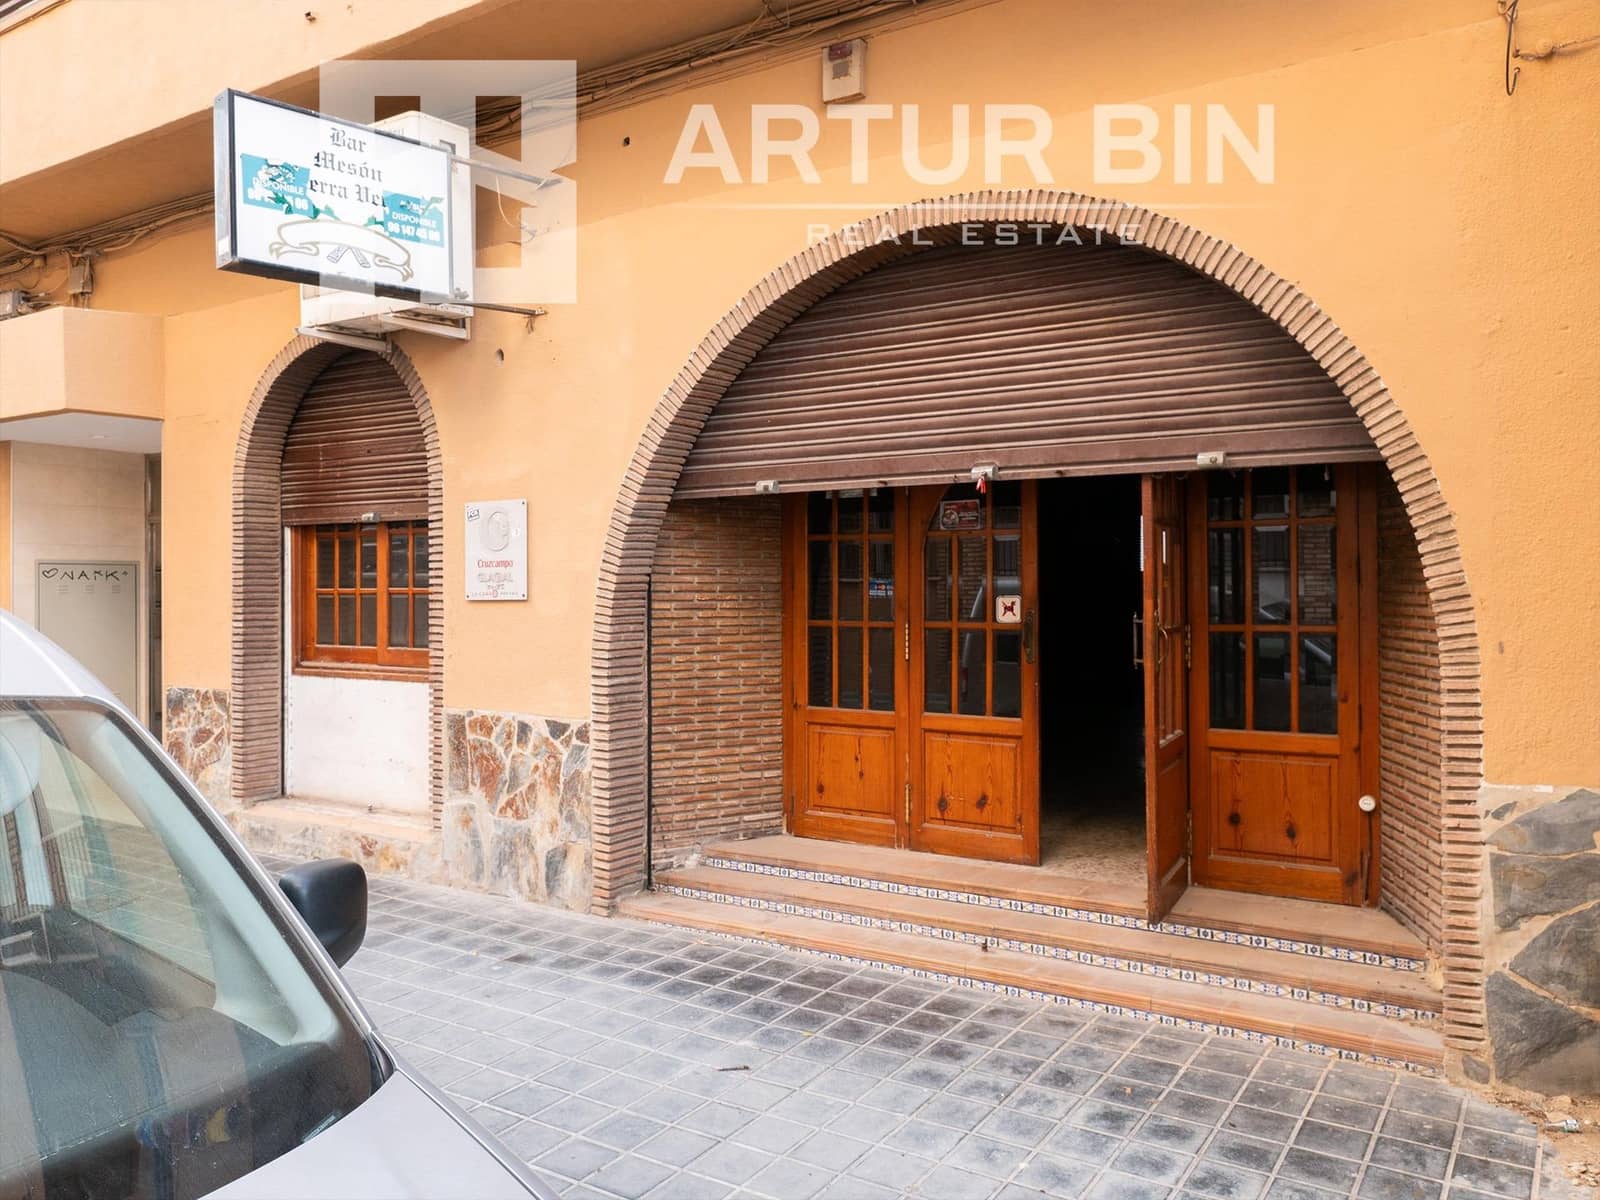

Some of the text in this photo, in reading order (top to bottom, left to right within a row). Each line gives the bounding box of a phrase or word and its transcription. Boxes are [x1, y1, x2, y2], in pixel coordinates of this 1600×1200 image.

[330, 127, 367, 152] Bar
[313, 149, 382, 182] Mesón
[309, 180, 348, 199] erra
[391, 211, 437, 229] DISPONIBLE
[477, 559, 514, 570] Cruzcampo
